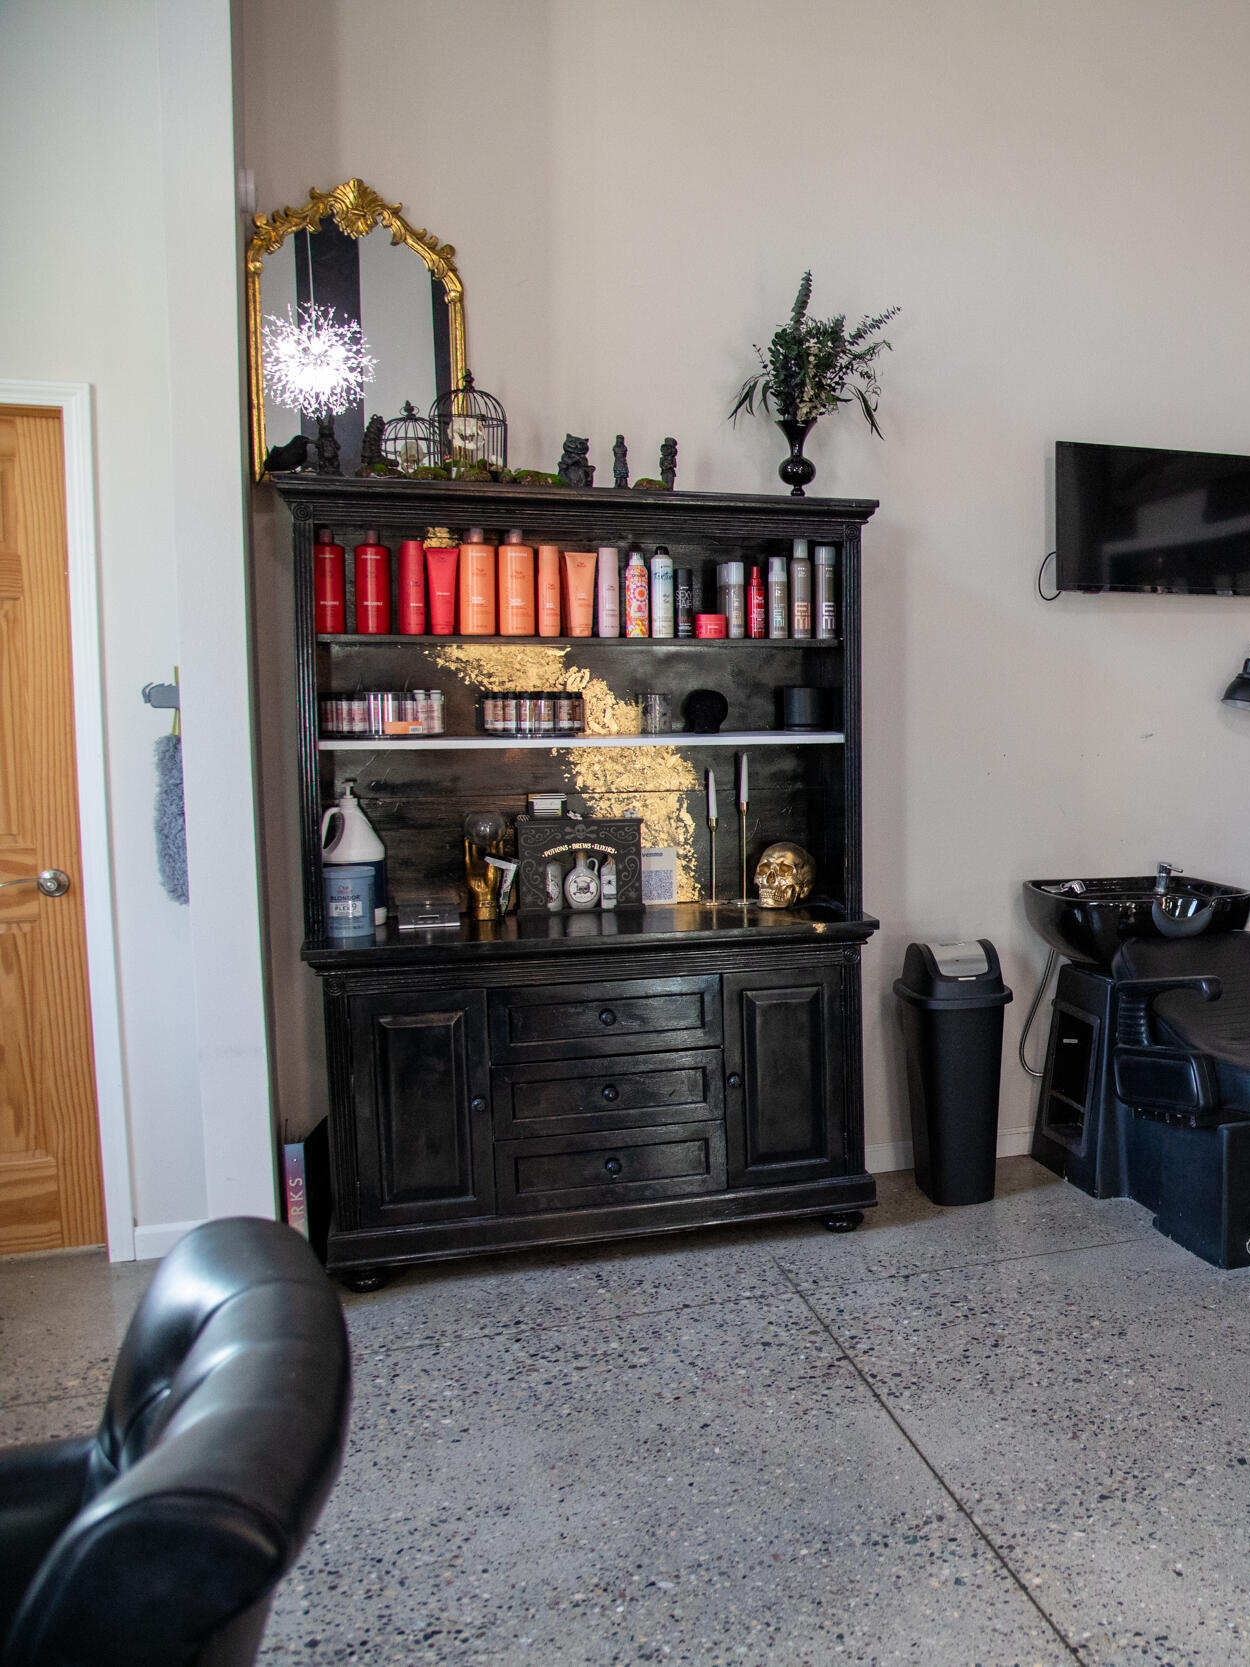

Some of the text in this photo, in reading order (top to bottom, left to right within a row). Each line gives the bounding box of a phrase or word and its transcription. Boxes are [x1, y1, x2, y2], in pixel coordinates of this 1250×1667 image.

[543, 842, 615, 857] POTIONS BREWS ELIXIRS
